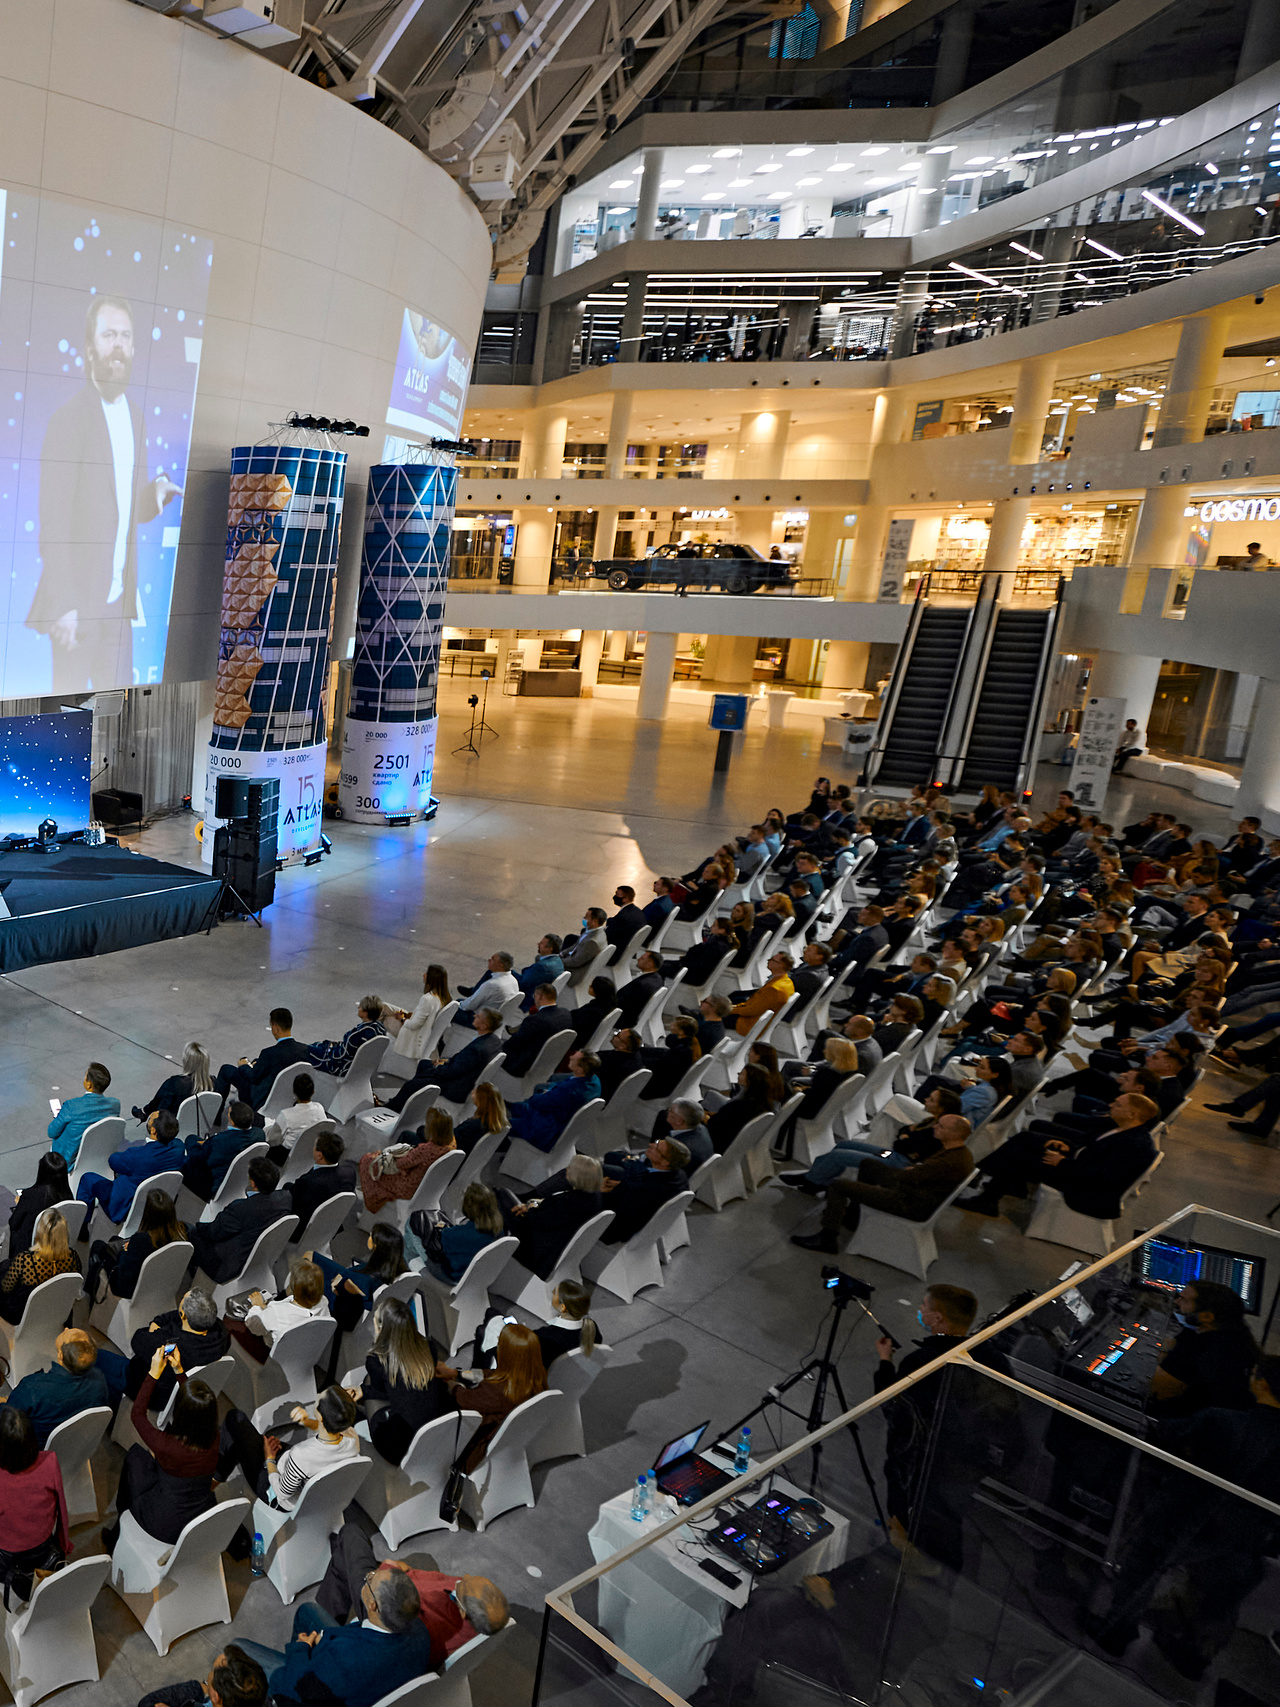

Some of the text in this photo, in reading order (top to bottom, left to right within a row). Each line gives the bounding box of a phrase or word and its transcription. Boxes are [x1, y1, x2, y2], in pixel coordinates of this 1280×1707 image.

[881, 580, 898, 598] 2
[221, 756, 242, 768] 000
[283, 755, 295, 765] 328
[373, 754, 410, 770] 2501
[298, 774, 315, 810] 15
[356, 795, 380, 809] 300
[282, 798, 322, 826] ATLAS
